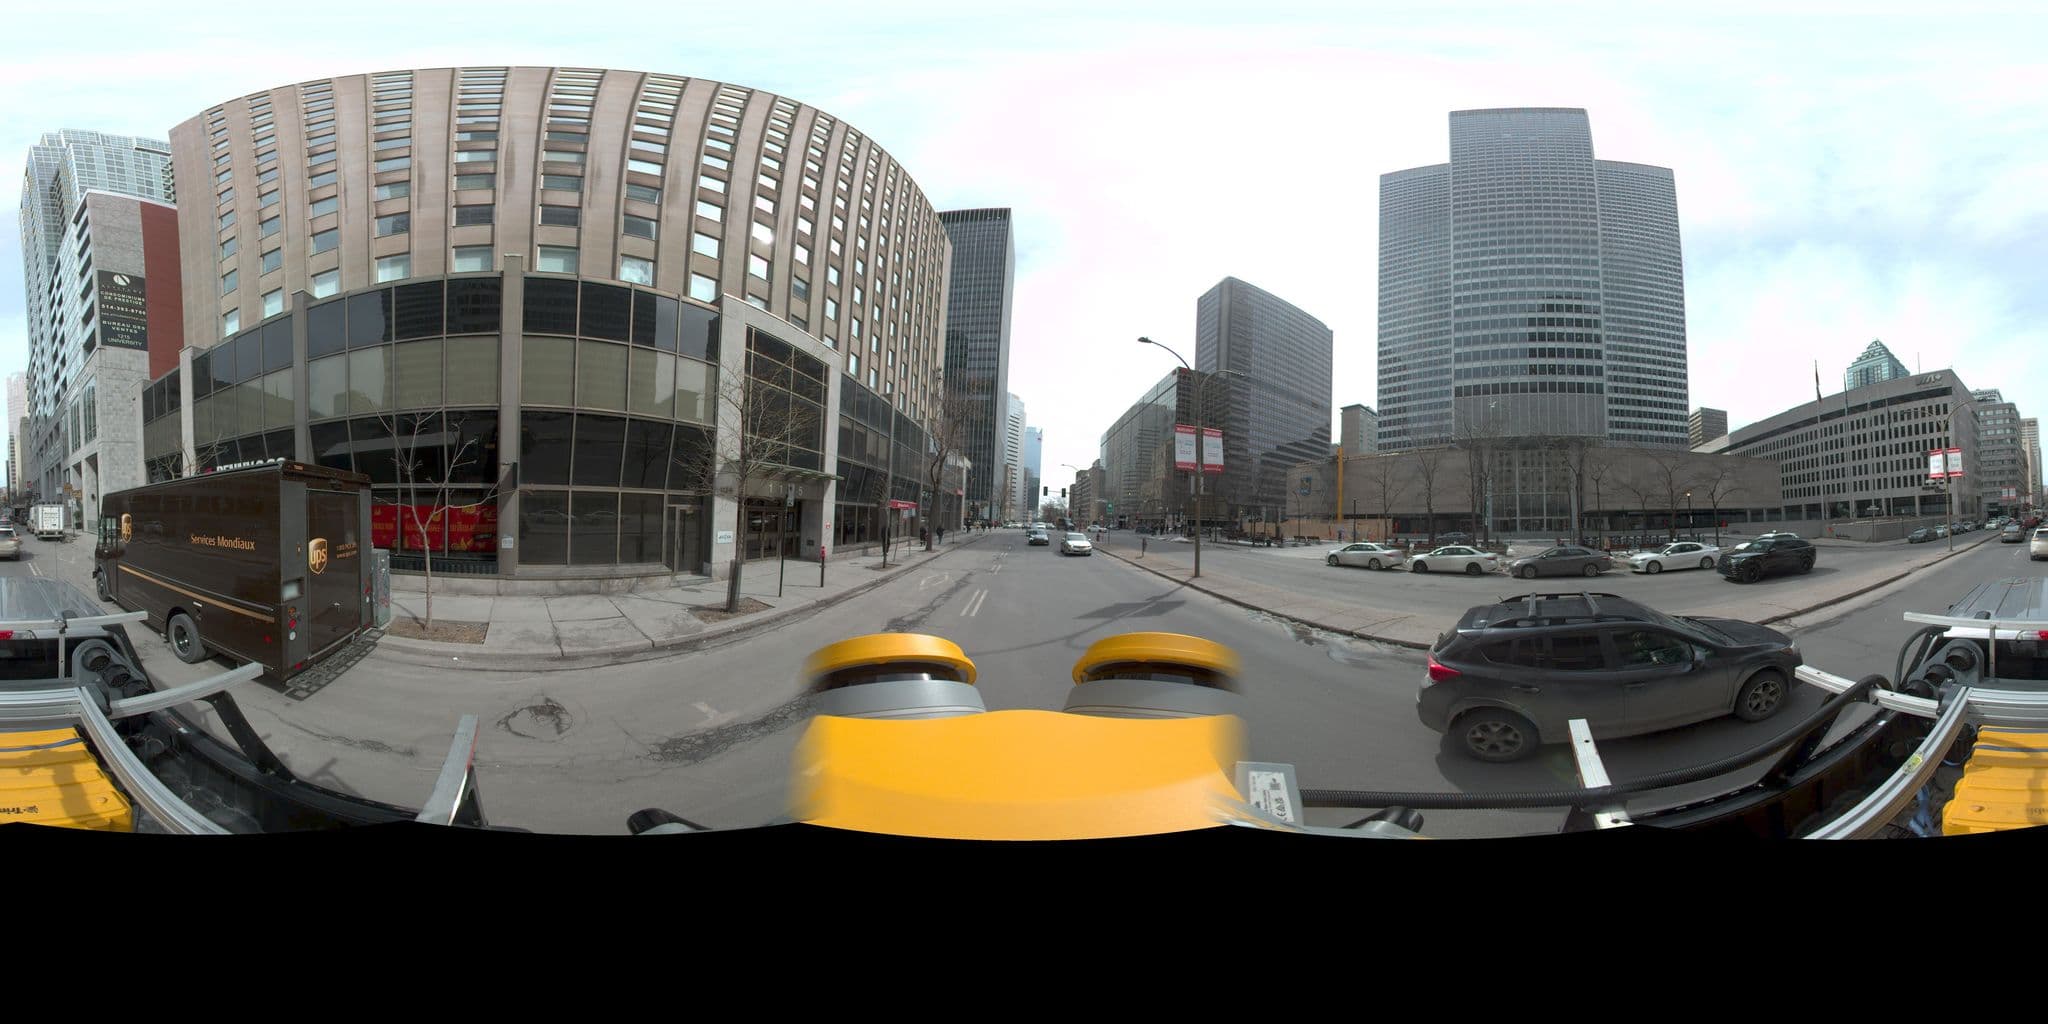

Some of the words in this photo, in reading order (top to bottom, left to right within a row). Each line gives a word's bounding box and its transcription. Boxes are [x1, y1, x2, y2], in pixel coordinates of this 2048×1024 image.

[102, 320, 131, 328] BUREAU
[111, 326, 138, 334] VENTES
[107, 337, 143, 346] UNIVERSITY
[191, 534, 216, 546] Services
[218, 535, 255, 551] Mondiaux
[311, 549, 327, 569] ups
